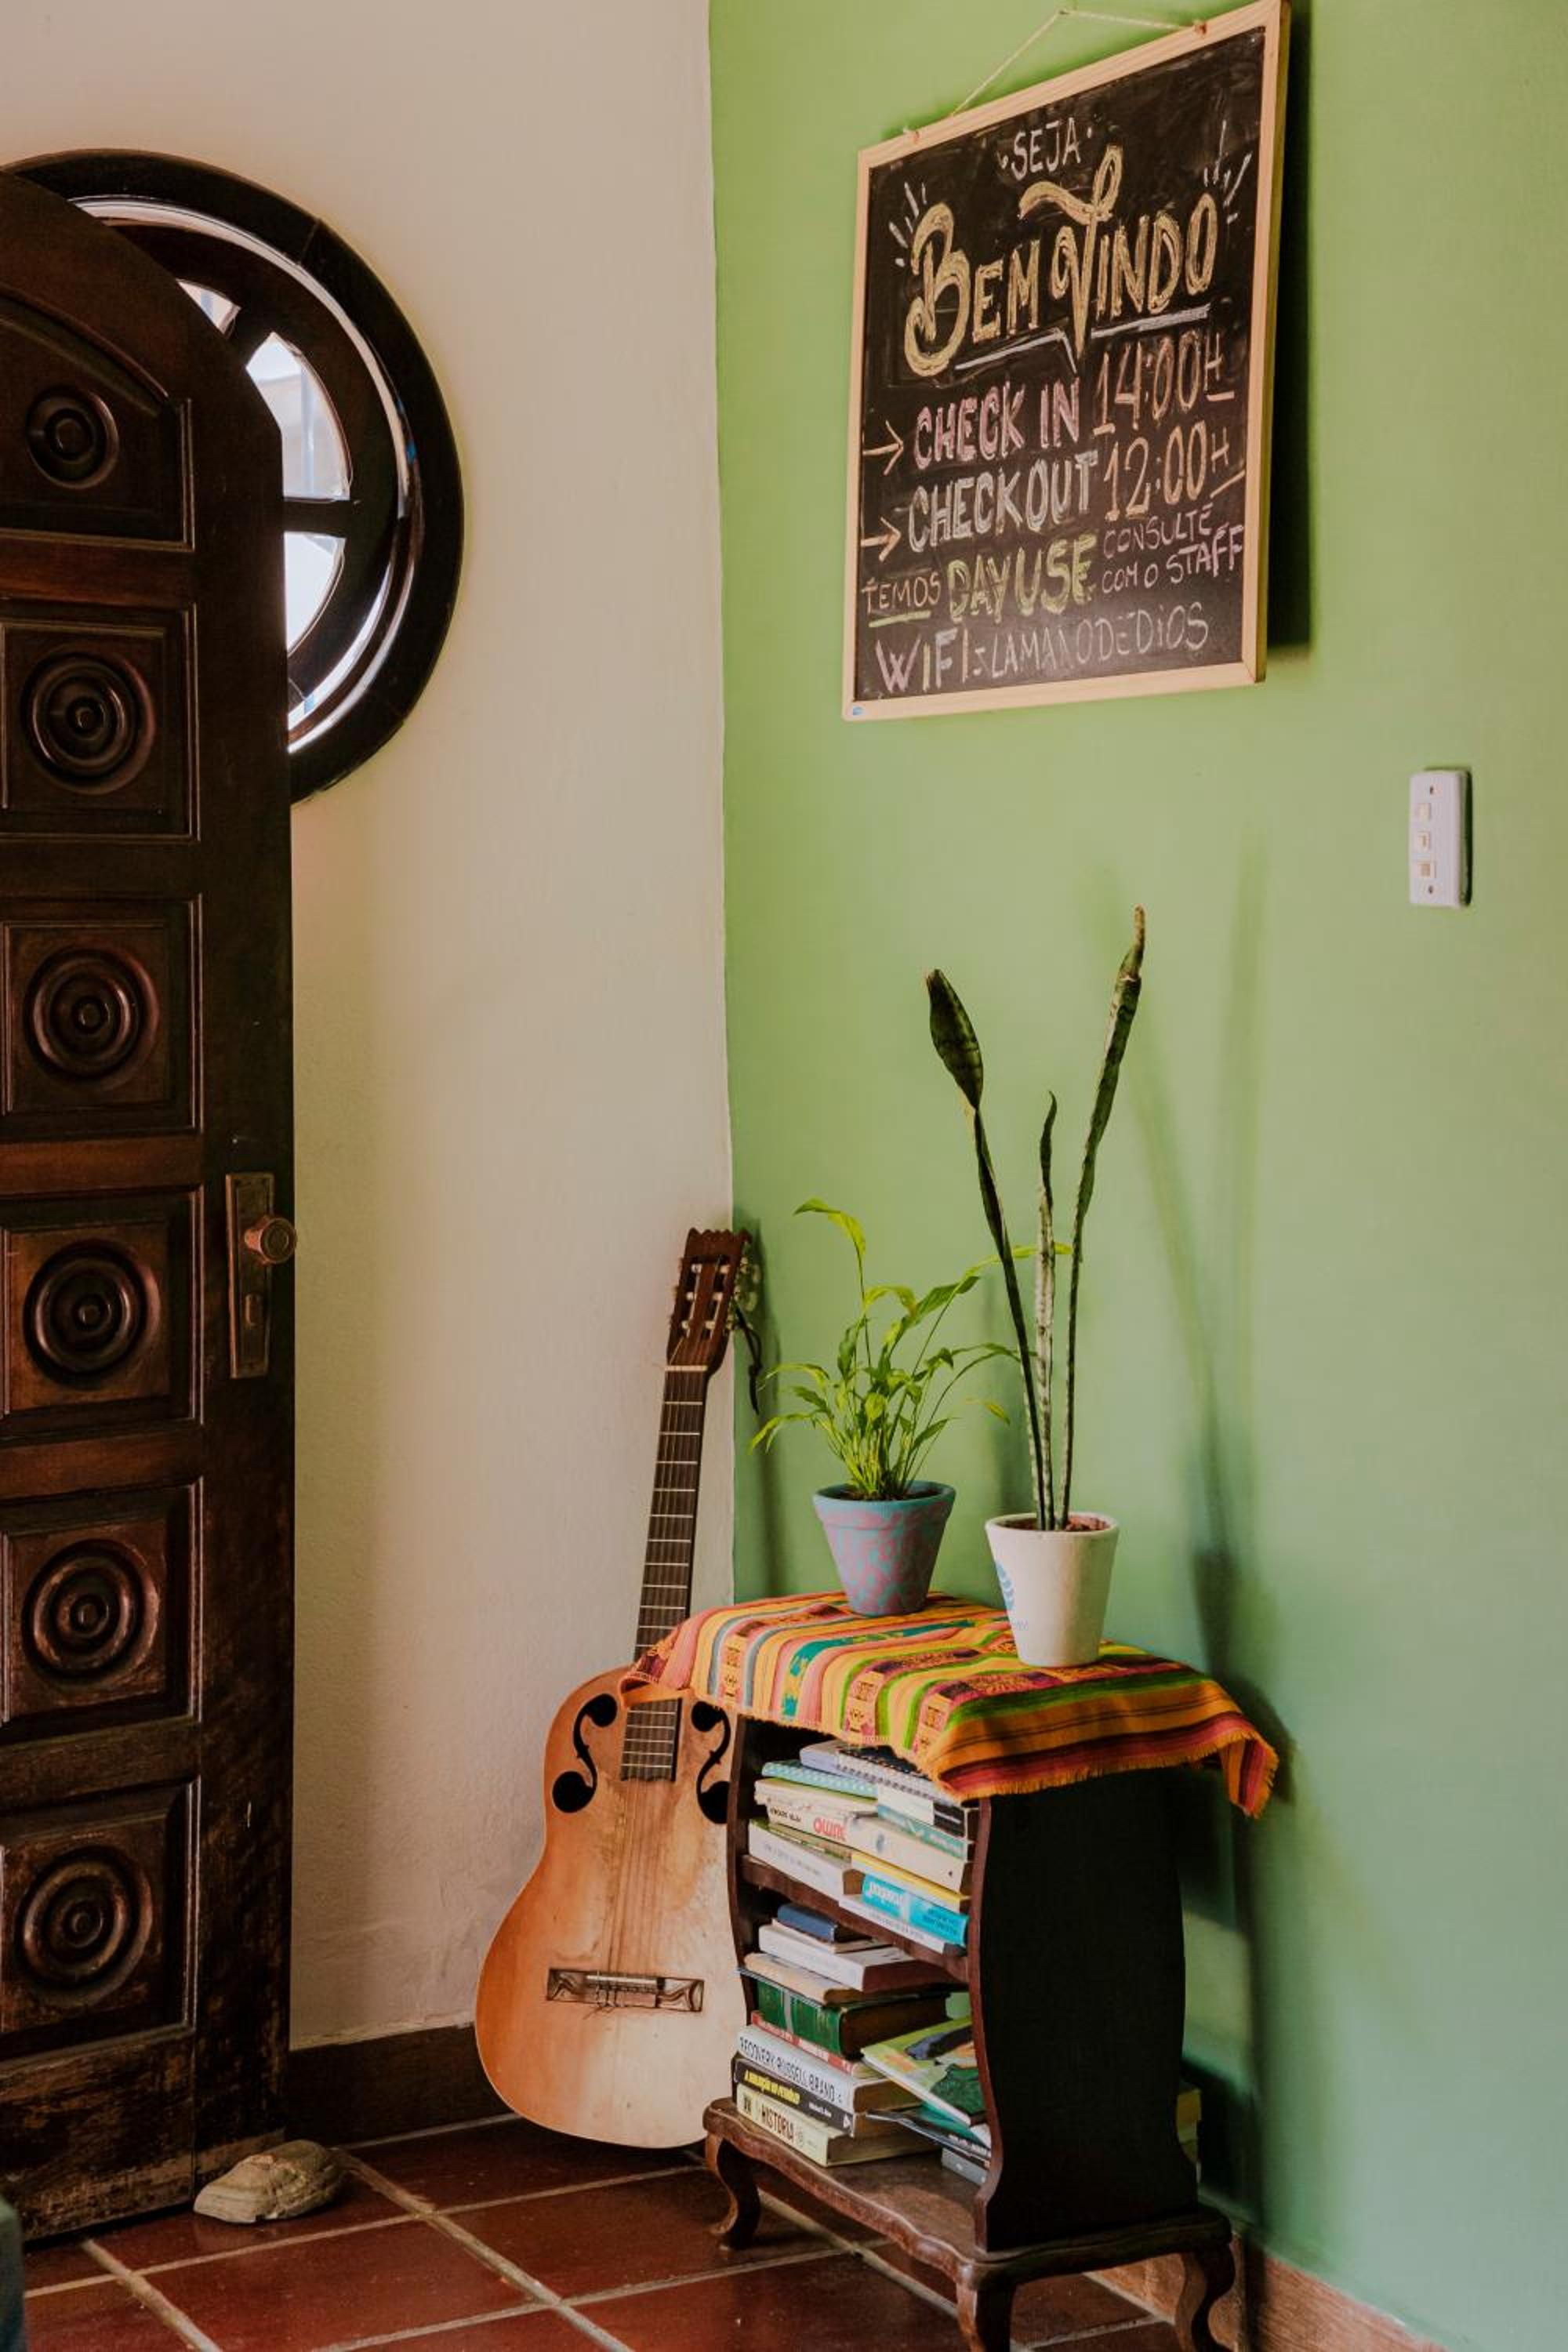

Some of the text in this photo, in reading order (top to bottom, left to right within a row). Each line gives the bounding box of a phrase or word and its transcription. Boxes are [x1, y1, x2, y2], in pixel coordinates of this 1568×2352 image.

[1009, 117, 1081, 181] SEJA
[904, 143, 1218, 377] BEM VINDO
[913, 380, 1025, 470] CHECK
[1040, 376, 1080, 448] IN
[1102, 522, 1245, 593] COM O STAFF
[1103, 503, 1214, 559] CONSULTE
[861, 571, 941, 614] TEMOS
[739, 2036, 775, 2070] RECOVERY
[809, 2074, 836, 2103] BRAND
